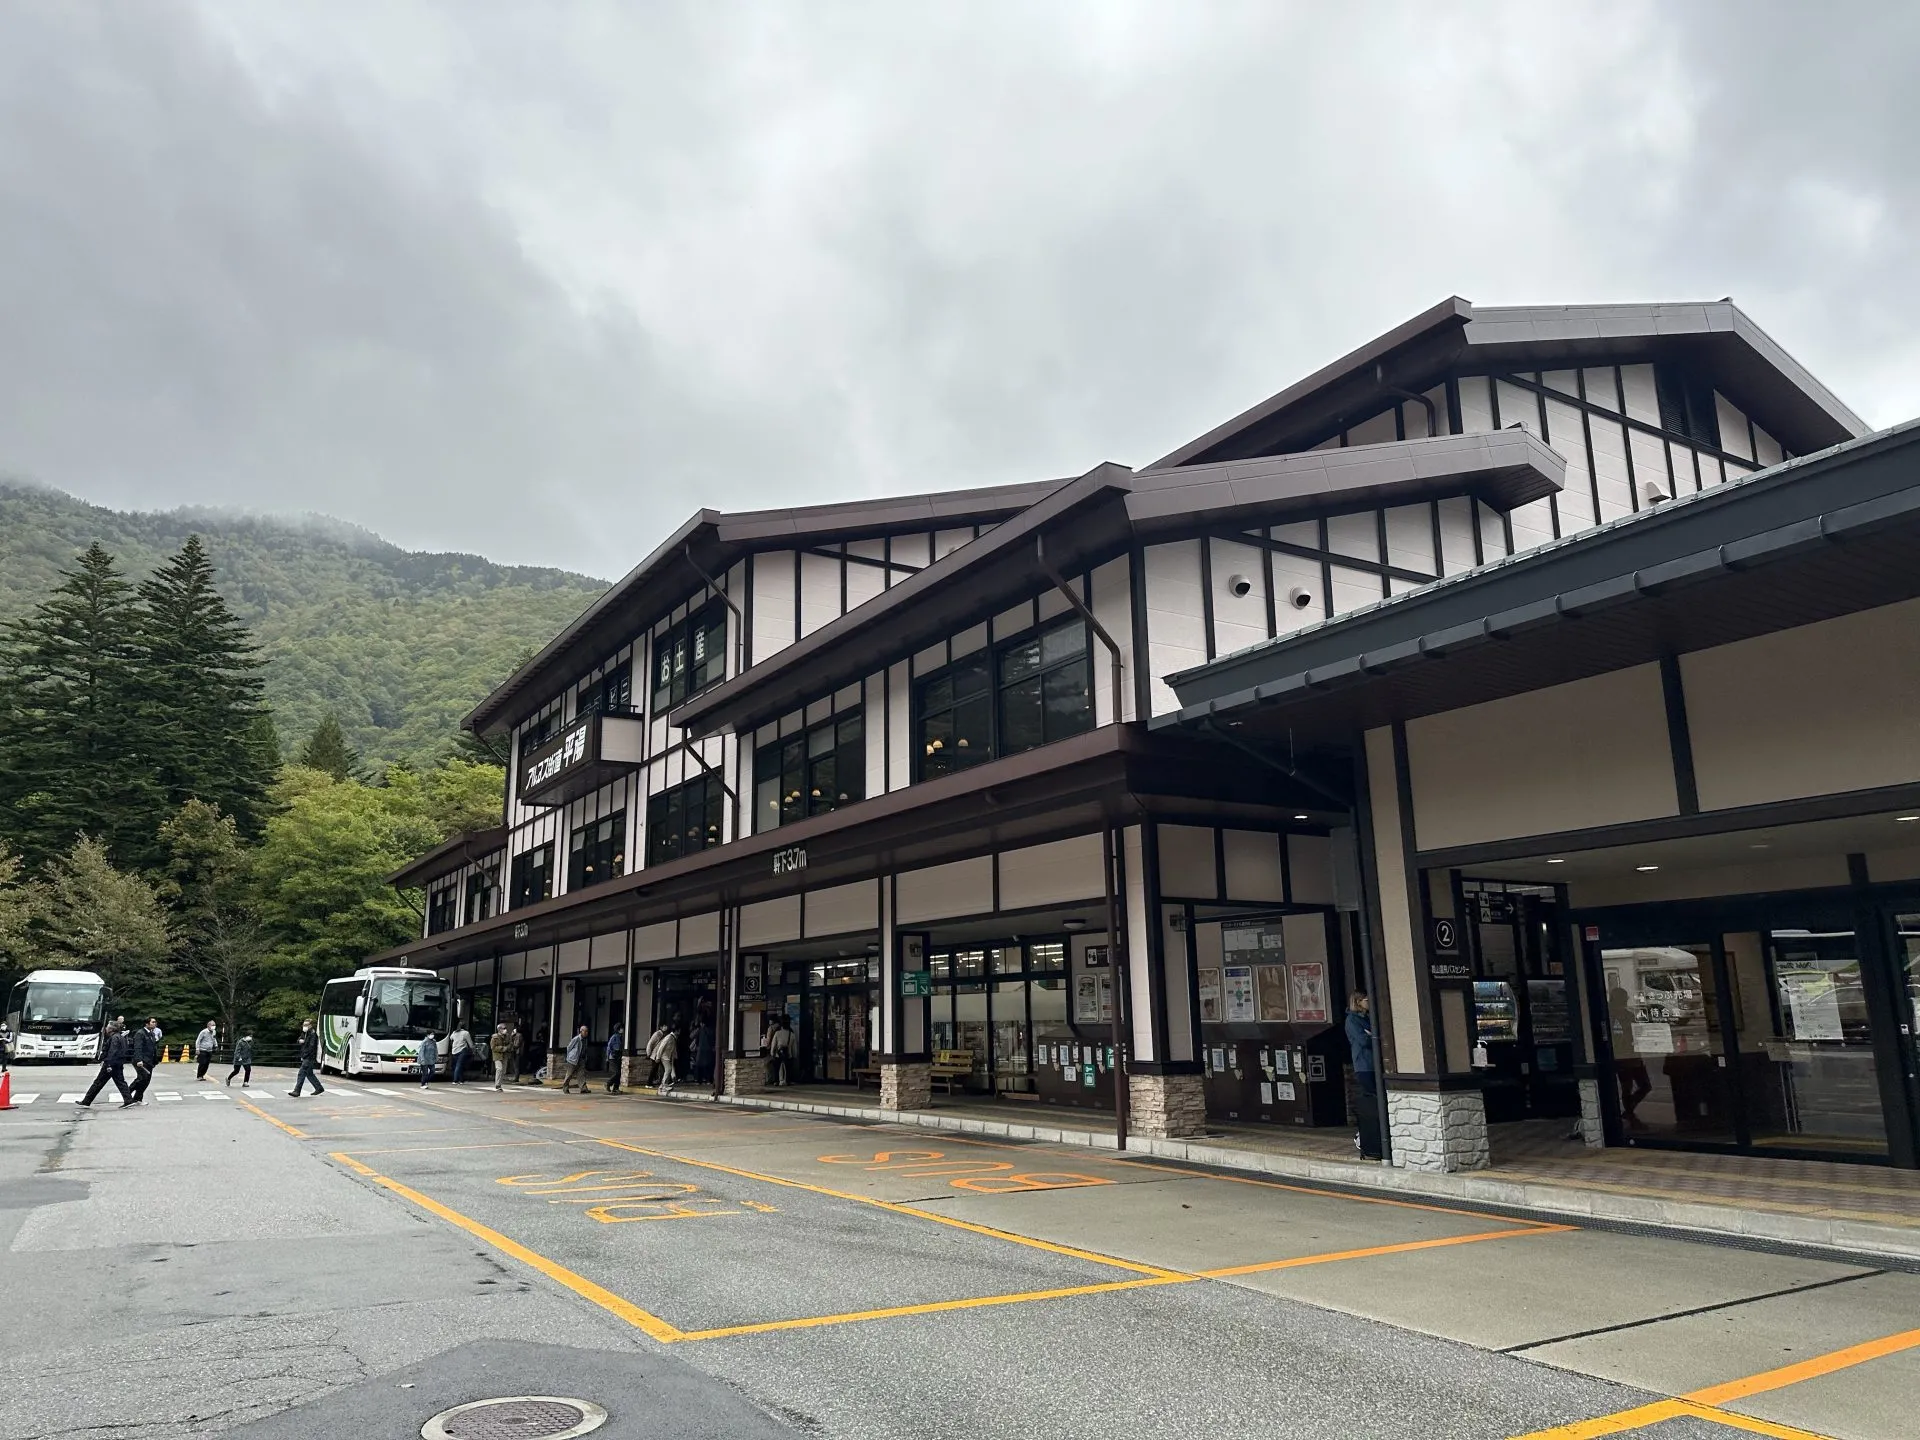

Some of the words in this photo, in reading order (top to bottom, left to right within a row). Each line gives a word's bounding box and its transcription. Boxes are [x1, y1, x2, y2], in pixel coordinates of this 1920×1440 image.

[661, 631, 705, 682] お土産
[525, 747, 563, 790] アルプス街道
[562, 724, 587, 767] 平湯
[1647, 989, 1693, 1000] きっぷ売場
[1650, 1007, 1681, 1018] 待合室
[816, 1151, 1115, 1194] BUS
